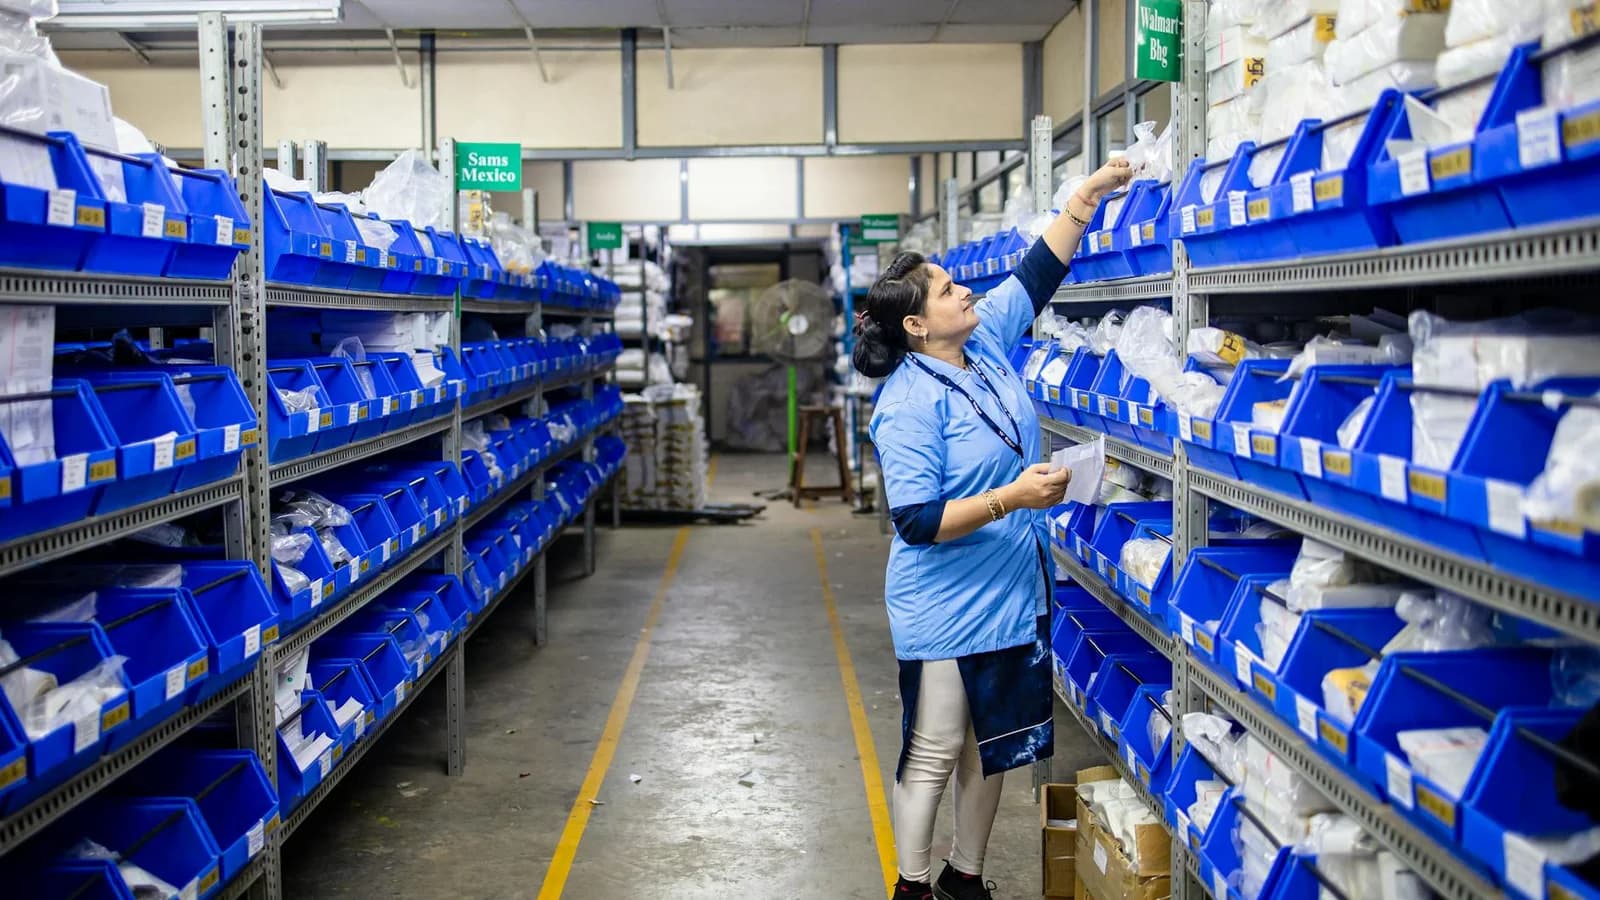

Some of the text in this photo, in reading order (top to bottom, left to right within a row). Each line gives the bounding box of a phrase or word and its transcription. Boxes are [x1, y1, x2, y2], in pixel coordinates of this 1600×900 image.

[1140, 6, 1179, 35] Walmart
[1150, 37, 1168, 69] Bhg
[468, 152, 509, 167] Sams
[462, 168, 516, 182] Mexico
